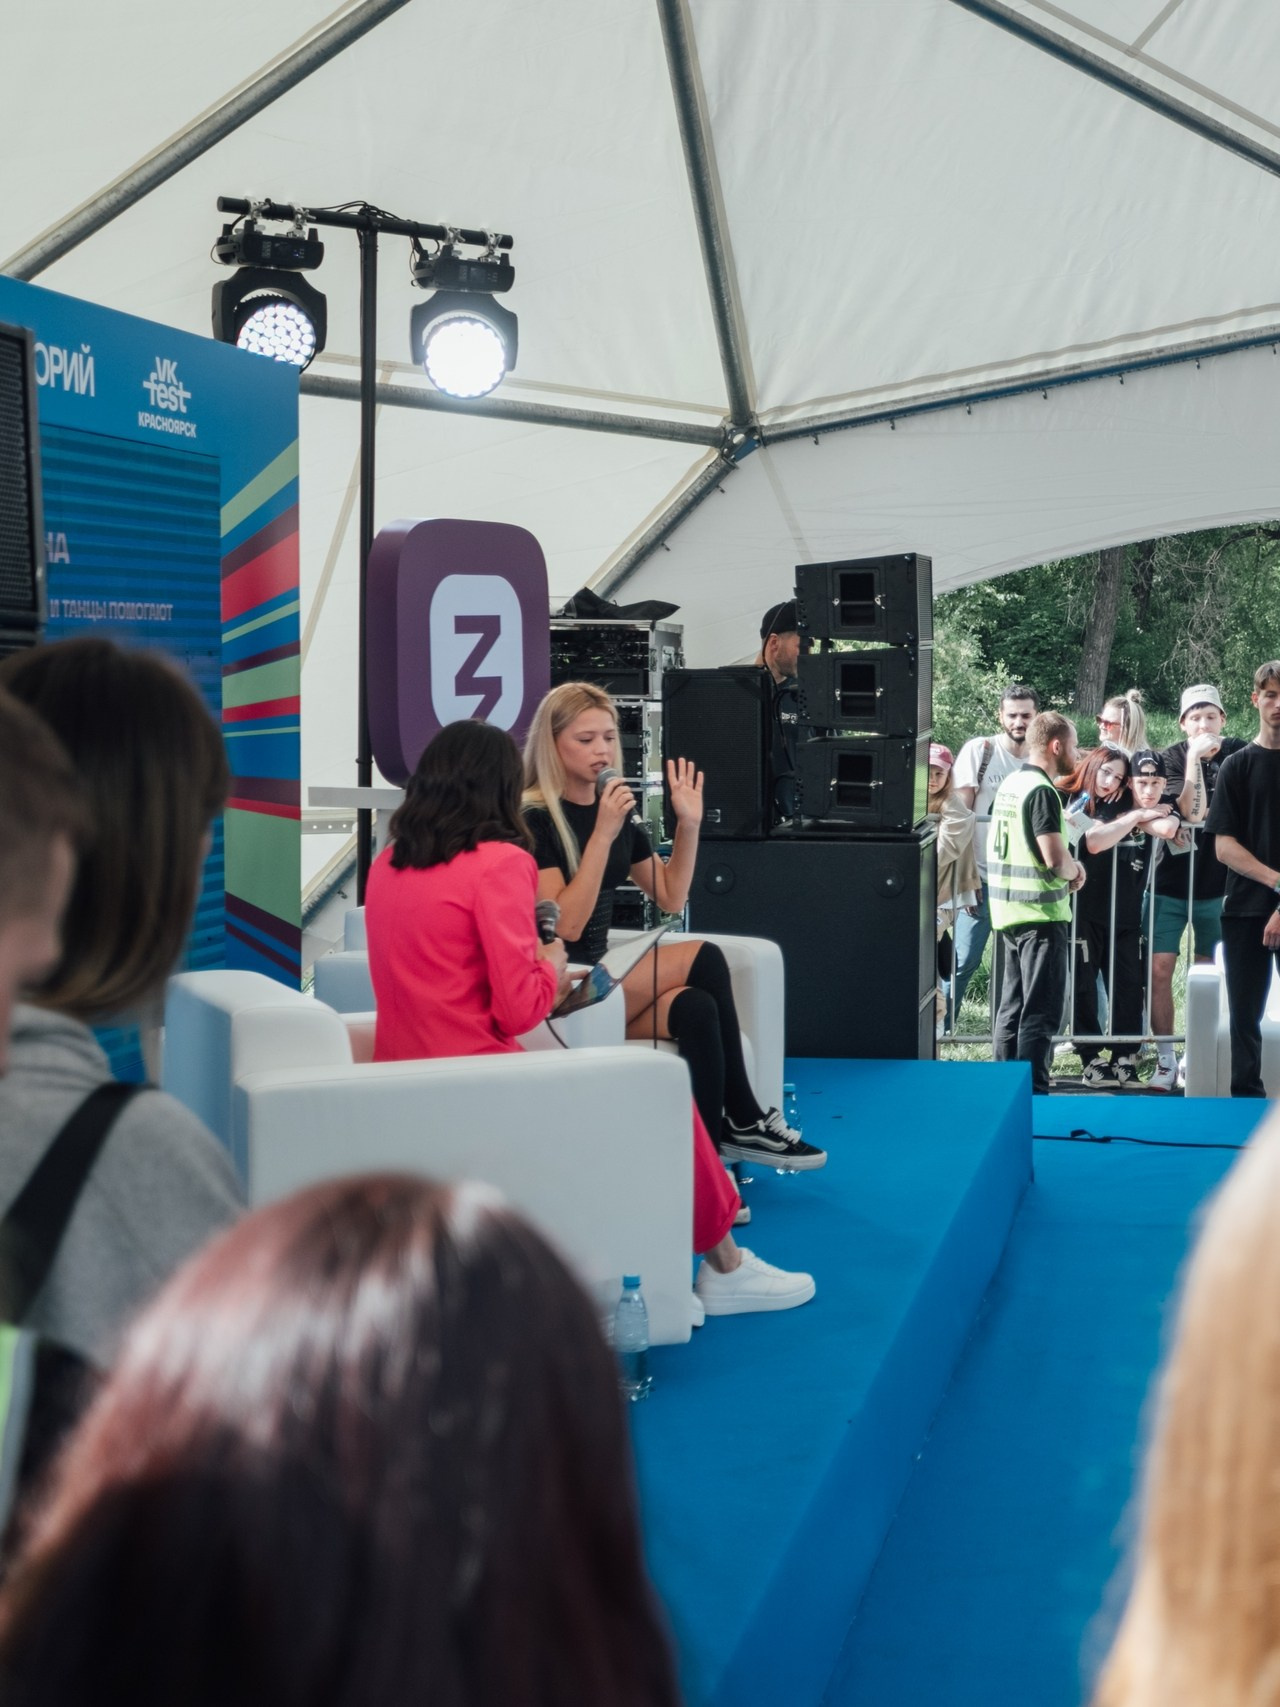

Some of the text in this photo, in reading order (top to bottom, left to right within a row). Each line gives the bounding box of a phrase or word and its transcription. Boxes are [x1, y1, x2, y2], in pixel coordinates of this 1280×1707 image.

[34, 342, 95, 397] ОРИЙ
[155, 356, 178, 385] VK
[143, 372, 191, 413] fest
[138, 411, 197, 438] КРАСНОЯРСК
[62, 599, 107, 621] ТАНЦЫ
[109, 601, 174, 621] ПОМОГАЮТ
